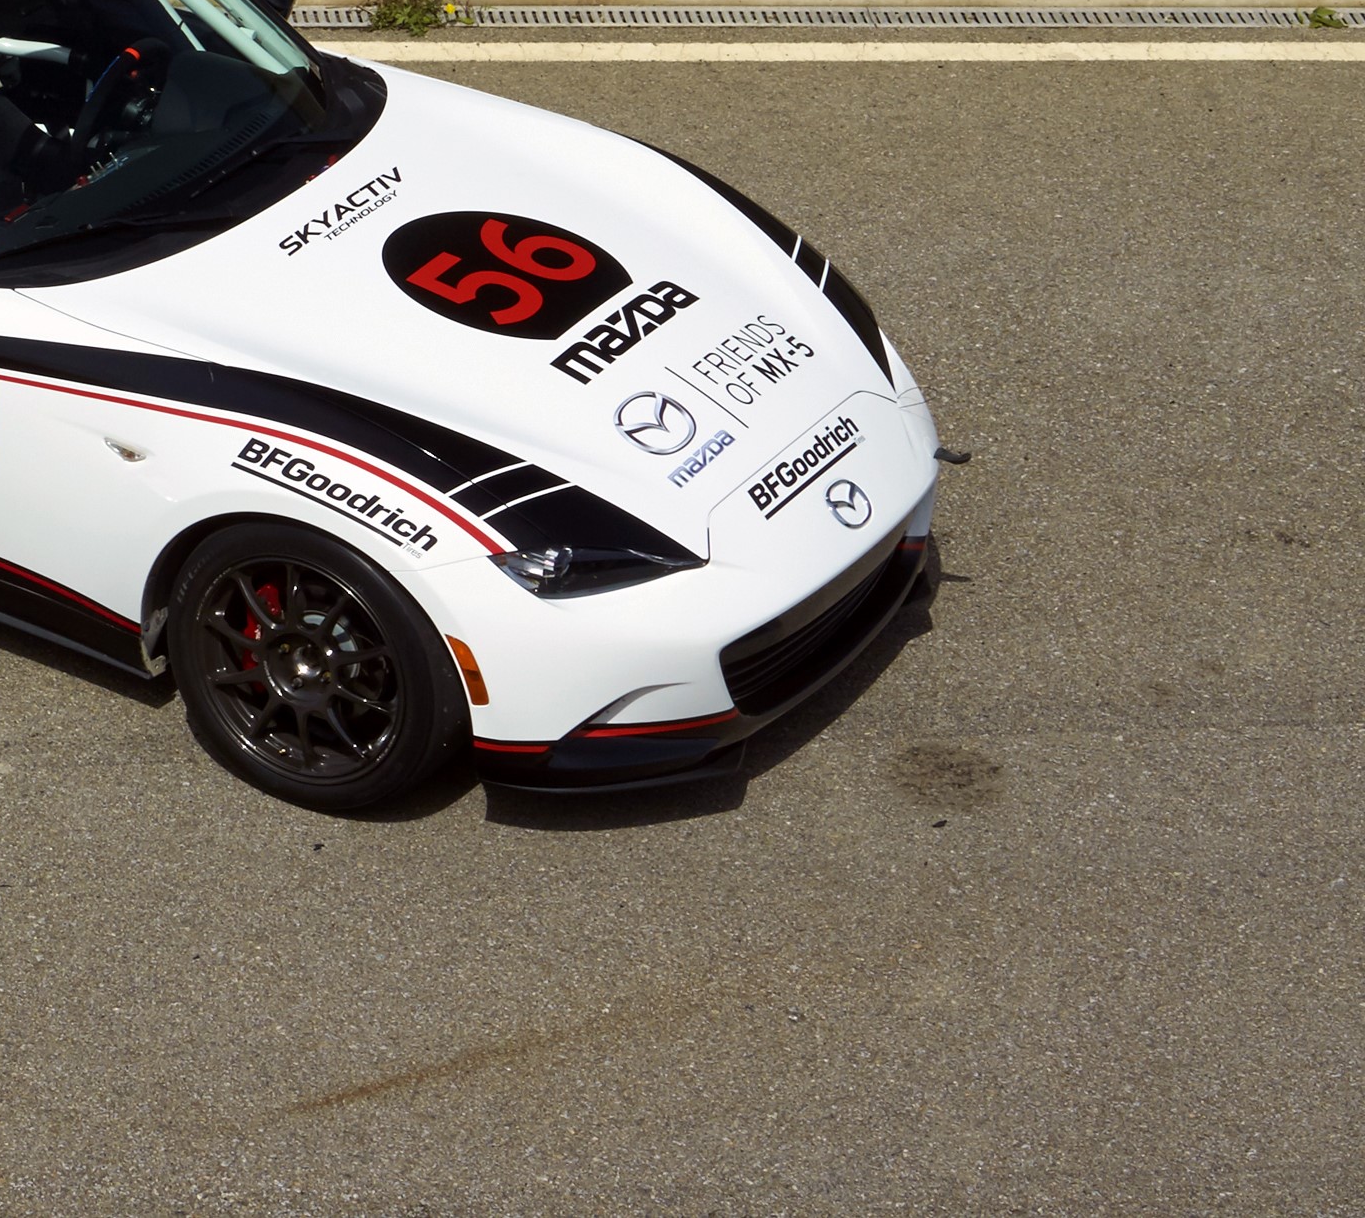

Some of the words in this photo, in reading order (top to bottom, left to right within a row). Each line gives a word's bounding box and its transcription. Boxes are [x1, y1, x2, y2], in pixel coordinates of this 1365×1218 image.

[278, 166, 402, 257] SKYACTIV
[323, 189, 399, 241] TECHNOLOGY
[406, 218, 597, 326] 56
[692, 314, 787, 384] FRIENDS
[724, 372, 761, 406] OF
[760, 334, 814, 384] MX-5
[237, 437, 438, 552] BFGoodrich
[746, 413, 859, 512] BFGoodrich
